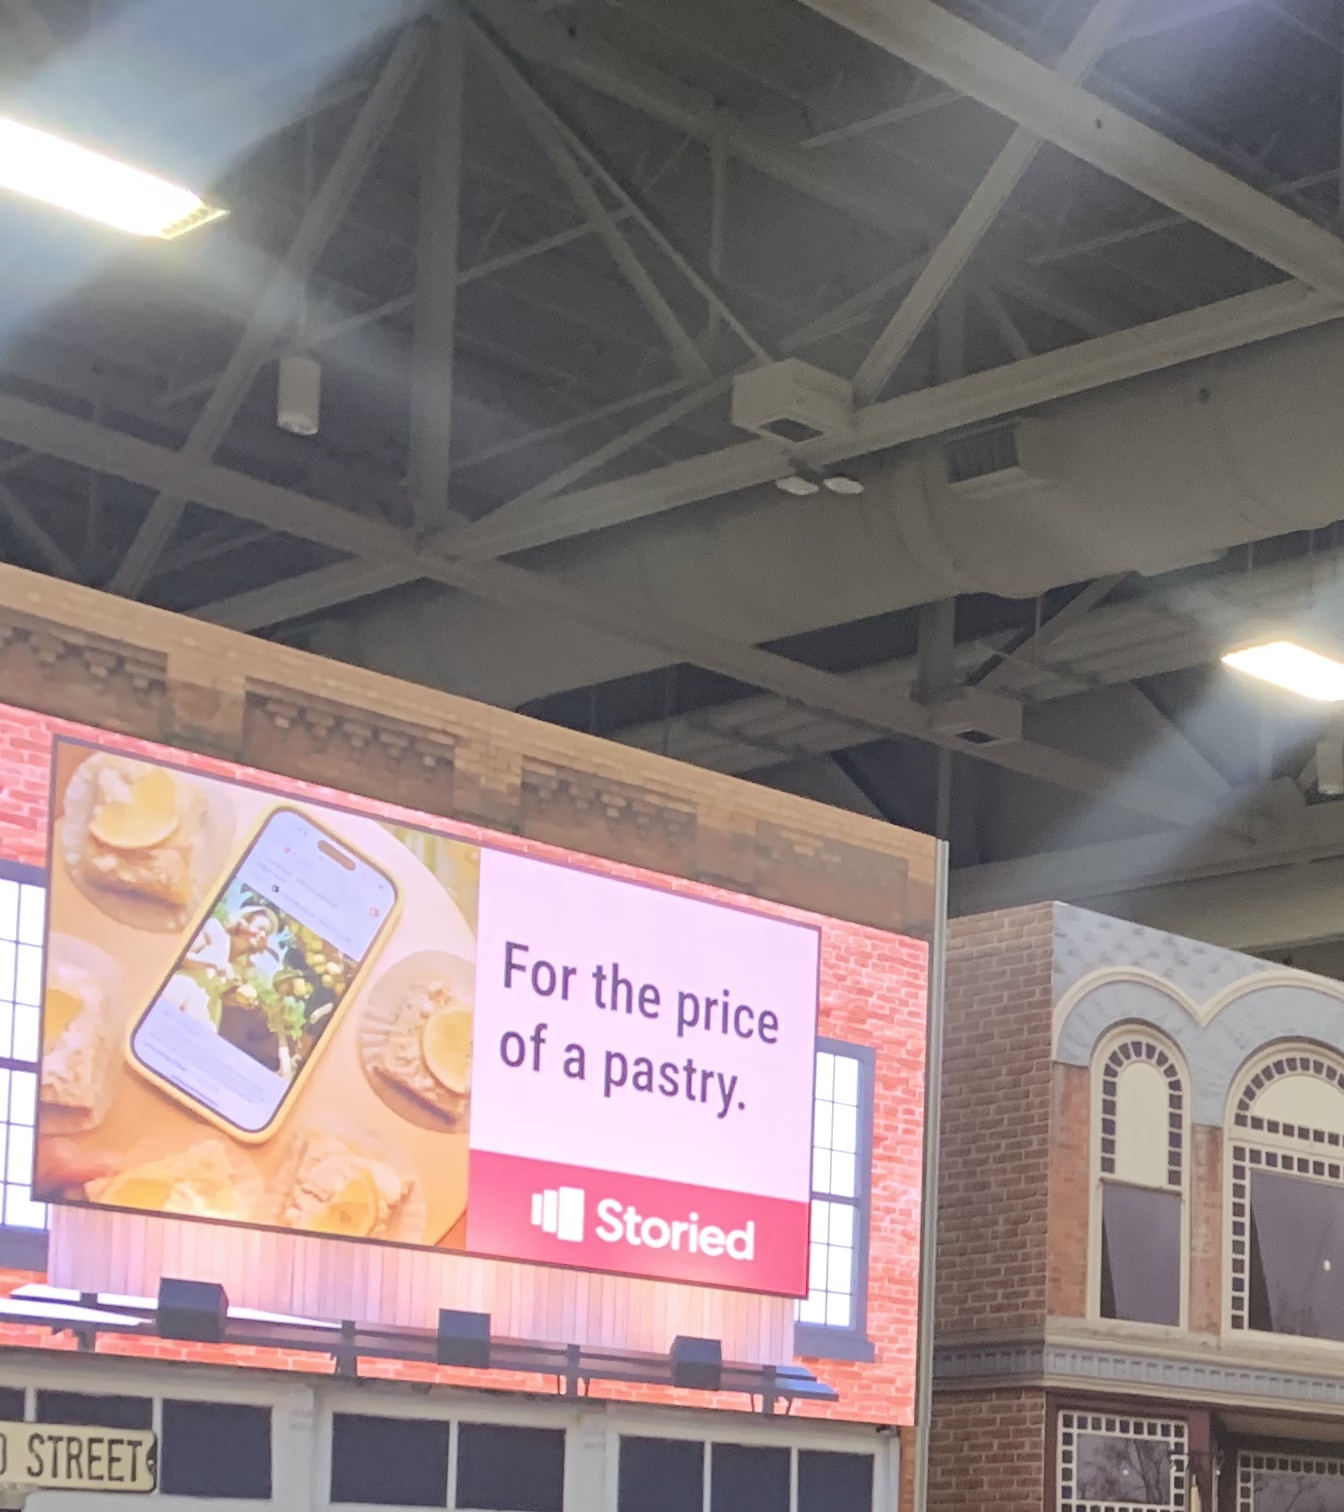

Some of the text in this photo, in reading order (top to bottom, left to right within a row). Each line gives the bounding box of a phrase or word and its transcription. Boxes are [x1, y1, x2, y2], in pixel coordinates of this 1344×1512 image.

[503, 940, 780, 1044] For the price
[499, 1022, 745, 1119] of a pastry.
[595, 1198, 755, 1260] Storied
[26, 1432, 143, 1483] STREET
